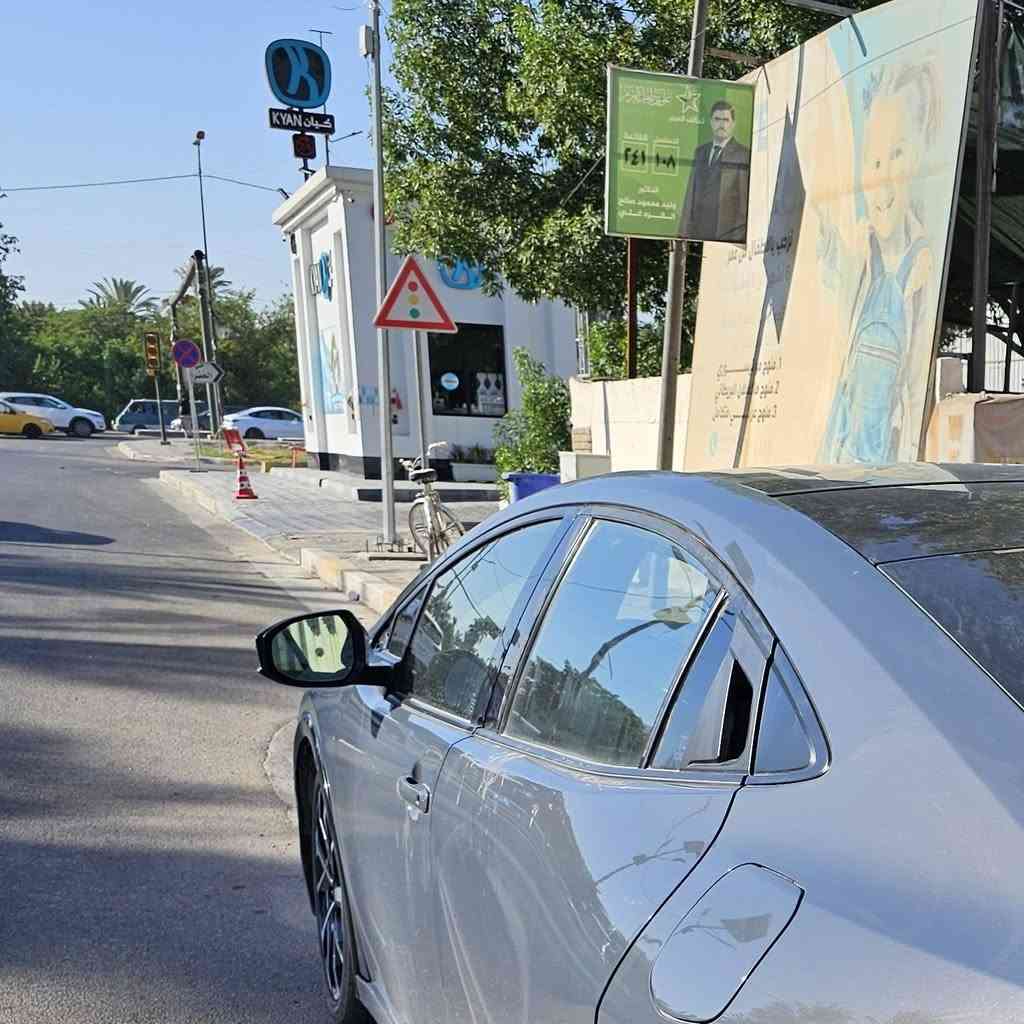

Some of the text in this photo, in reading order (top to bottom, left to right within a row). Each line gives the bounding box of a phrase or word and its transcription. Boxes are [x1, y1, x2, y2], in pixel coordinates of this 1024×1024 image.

[272, 111, 303, 128] KYAN
[303, 115, 332, 129] كيان
[624, 147, 646, 166] ٢٤١
